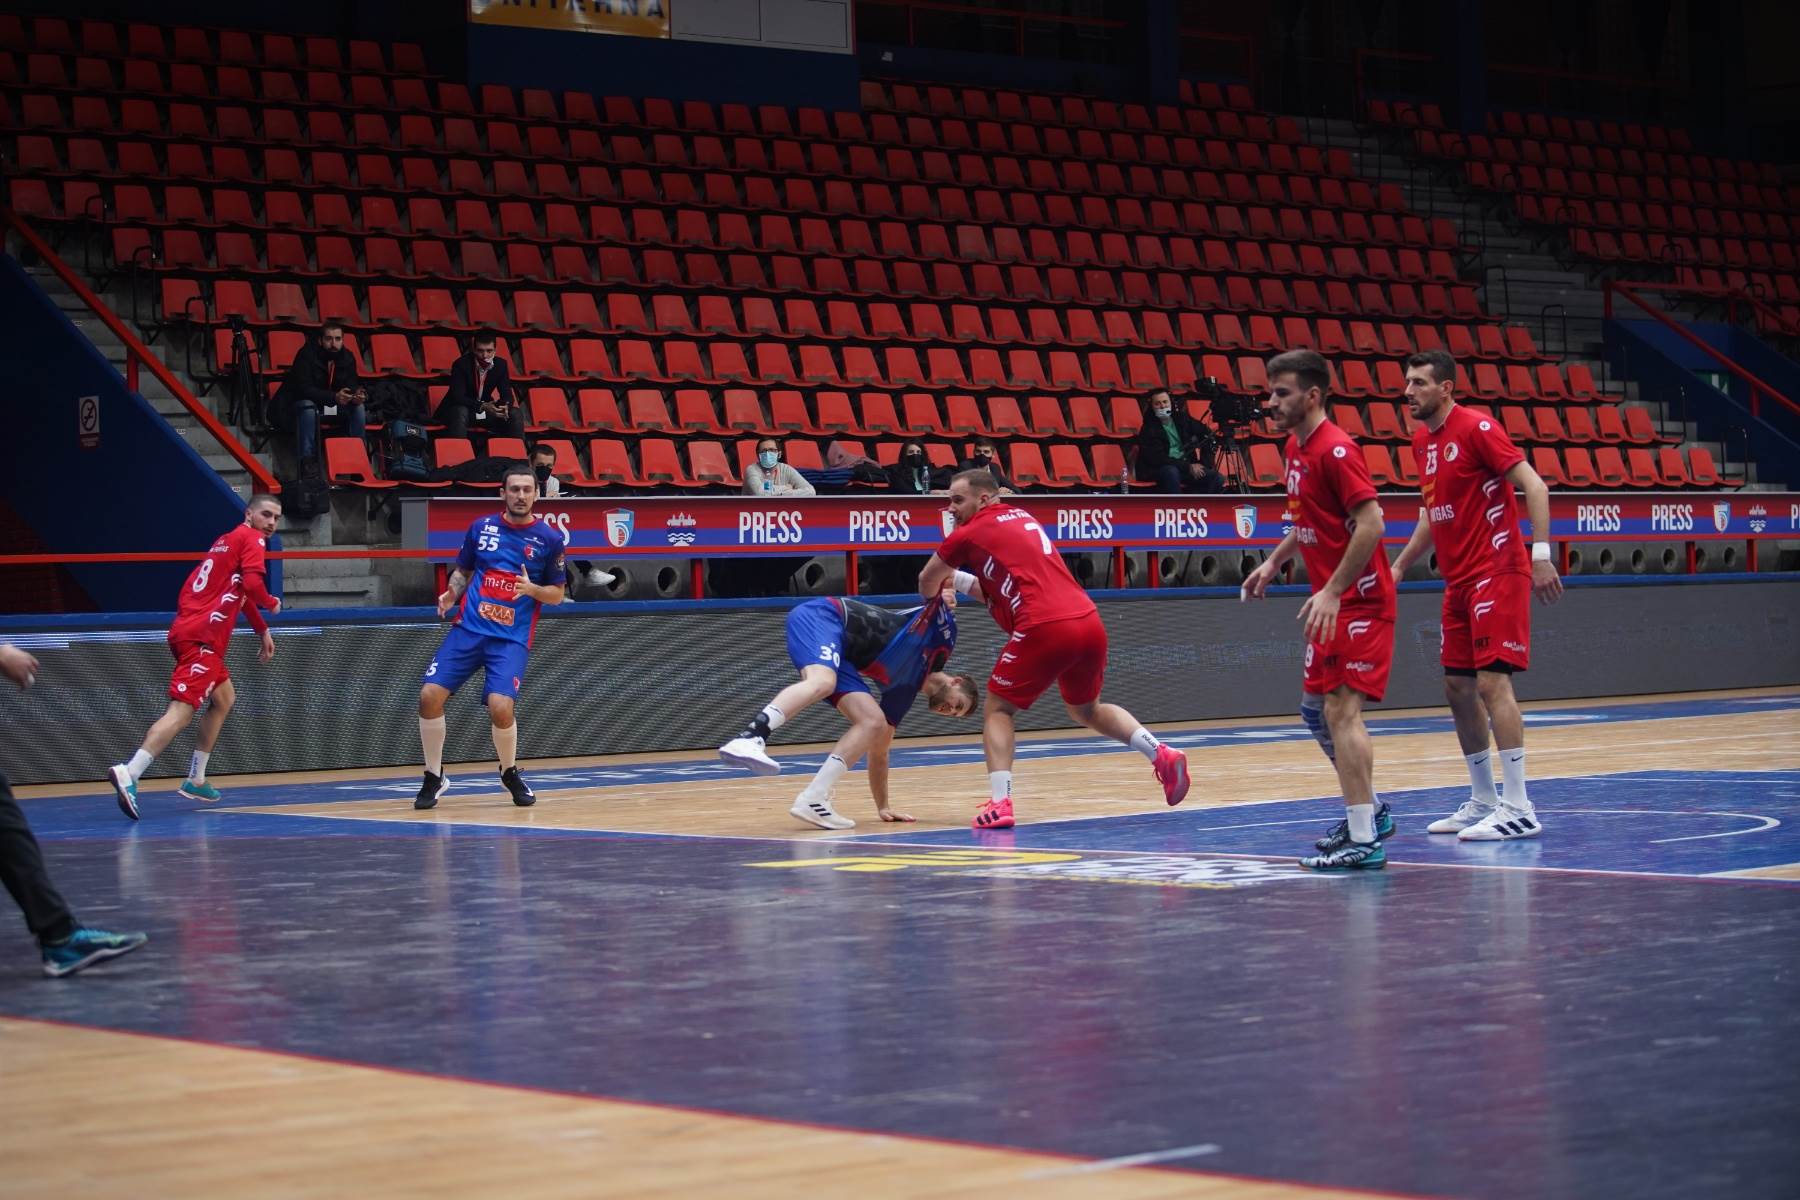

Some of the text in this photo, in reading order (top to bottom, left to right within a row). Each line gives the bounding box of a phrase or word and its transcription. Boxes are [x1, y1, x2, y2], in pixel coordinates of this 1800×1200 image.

[739, 511, 802, 543] PRESS
[849, 510, 911, 542] PRESS
[1057, 509, 1113, 540] PRESS
[1154, 508, 1208, 539] PRESS
[1577, 504, 1621, 532] PRESS
[1651, 504, 1693, 531] PRESS
[1791, 503, 1800, 529] P
[478, 535, 500, 552] 55
[1024, 522, 1053, 555] 7
[192, 558, 214, 593] 8
[819, 645, 840, 668] 30
